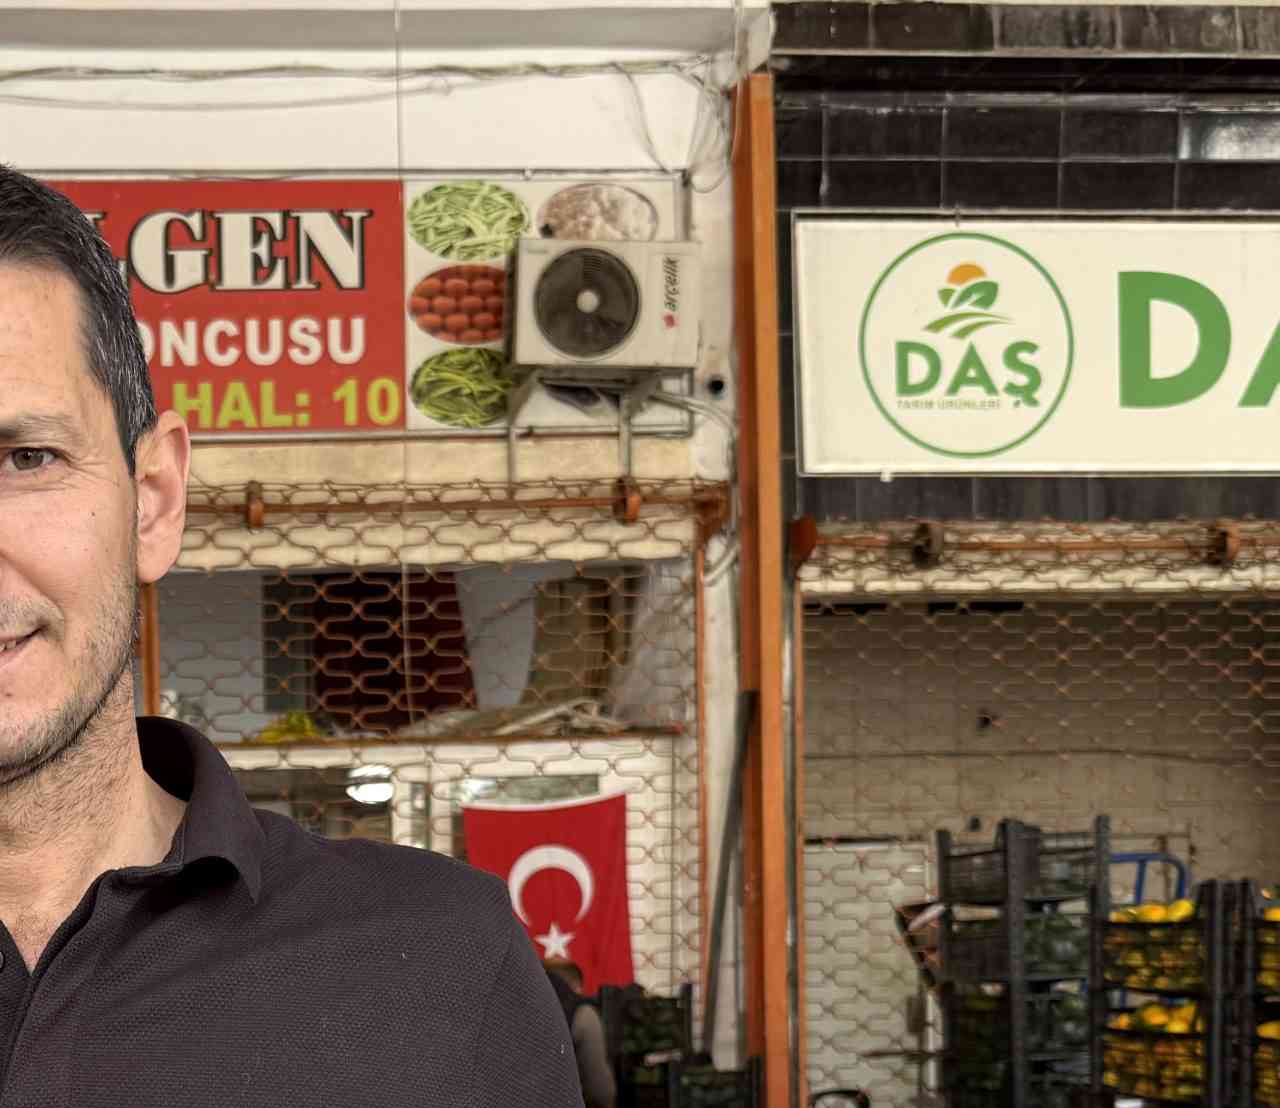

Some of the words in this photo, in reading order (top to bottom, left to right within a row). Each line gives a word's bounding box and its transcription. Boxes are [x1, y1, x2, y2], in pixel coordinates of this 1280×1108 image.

[80, 210, 373, 293] GEN
[172, 381, 311, 429] HAL:
[332, 377, 401, 426] 10
[895, 341, 1042, 407] DAŞ
